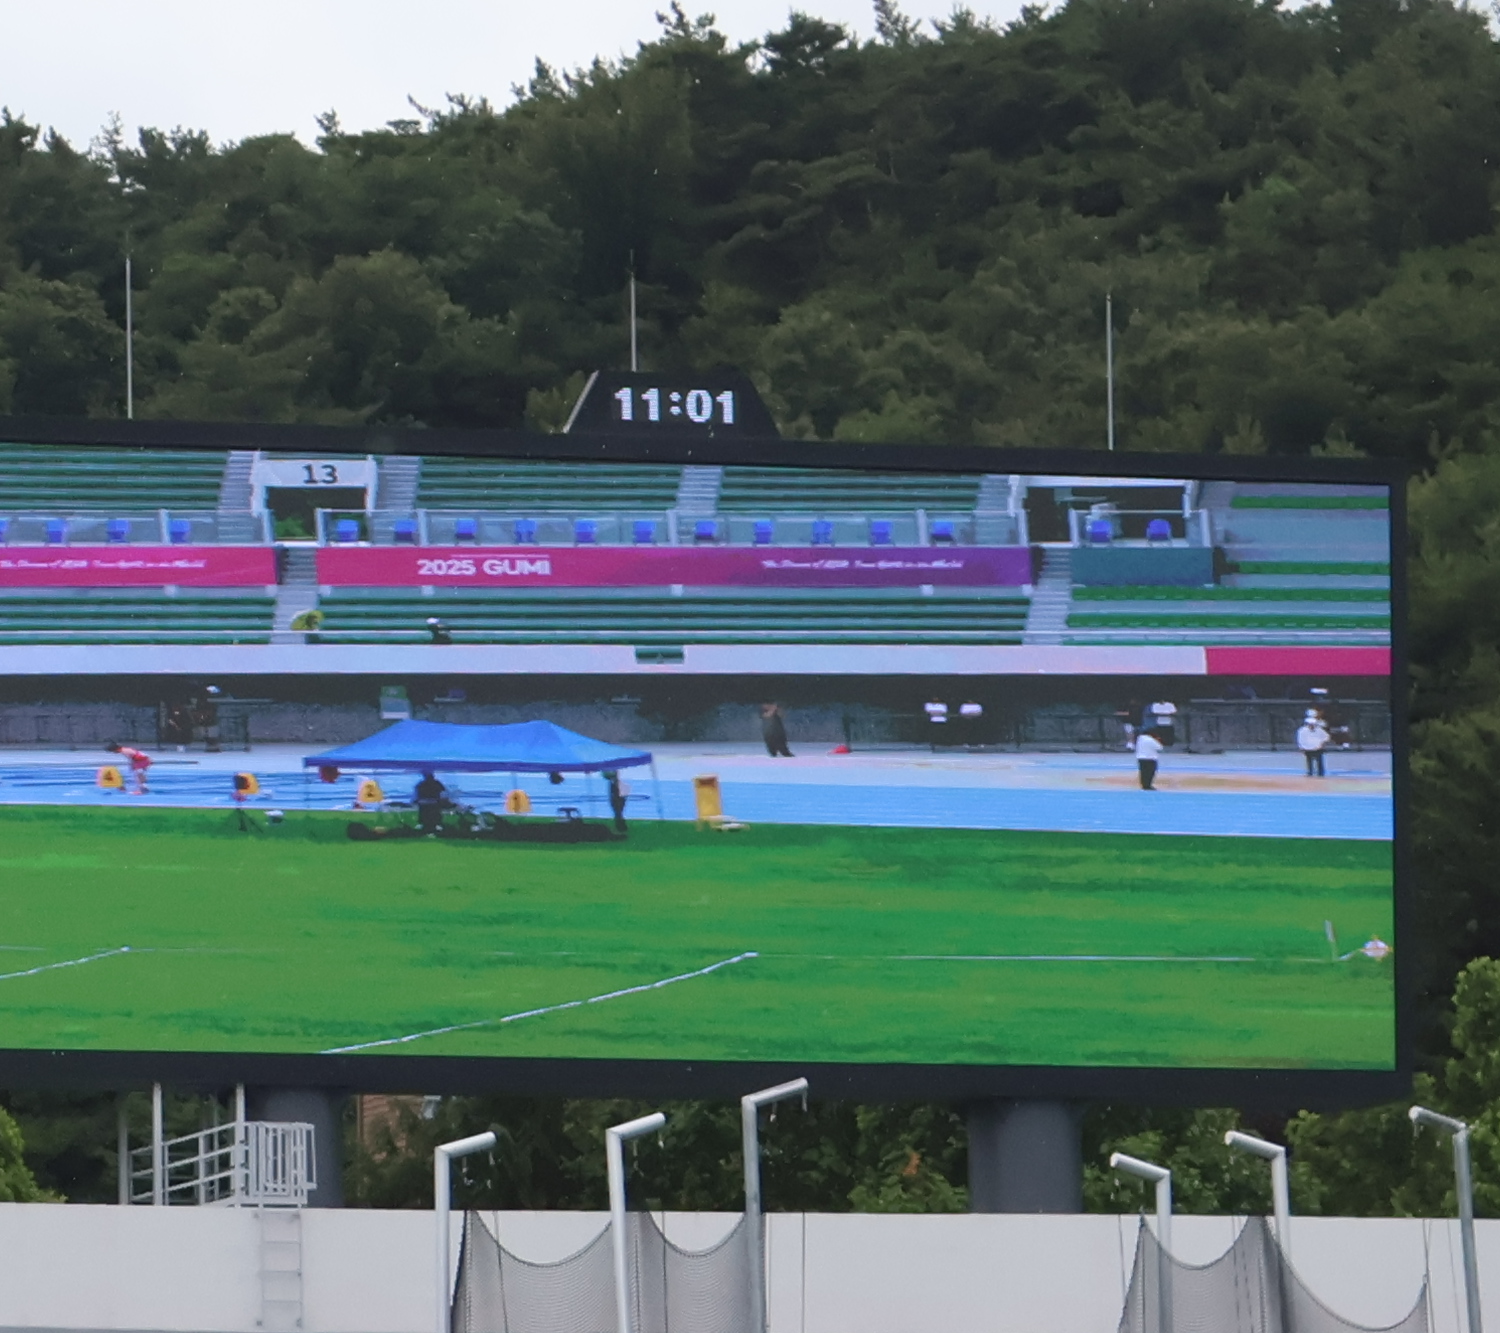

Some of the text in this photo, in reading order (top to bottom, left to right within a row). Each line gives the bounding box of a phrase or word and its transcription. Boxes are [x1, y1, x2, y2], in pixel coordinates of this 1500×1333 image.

[615, 387, 734, 424] 11:01
[302, 464, 338, 484] 13
[416, 558, 551, 576] 2025 GUMI
